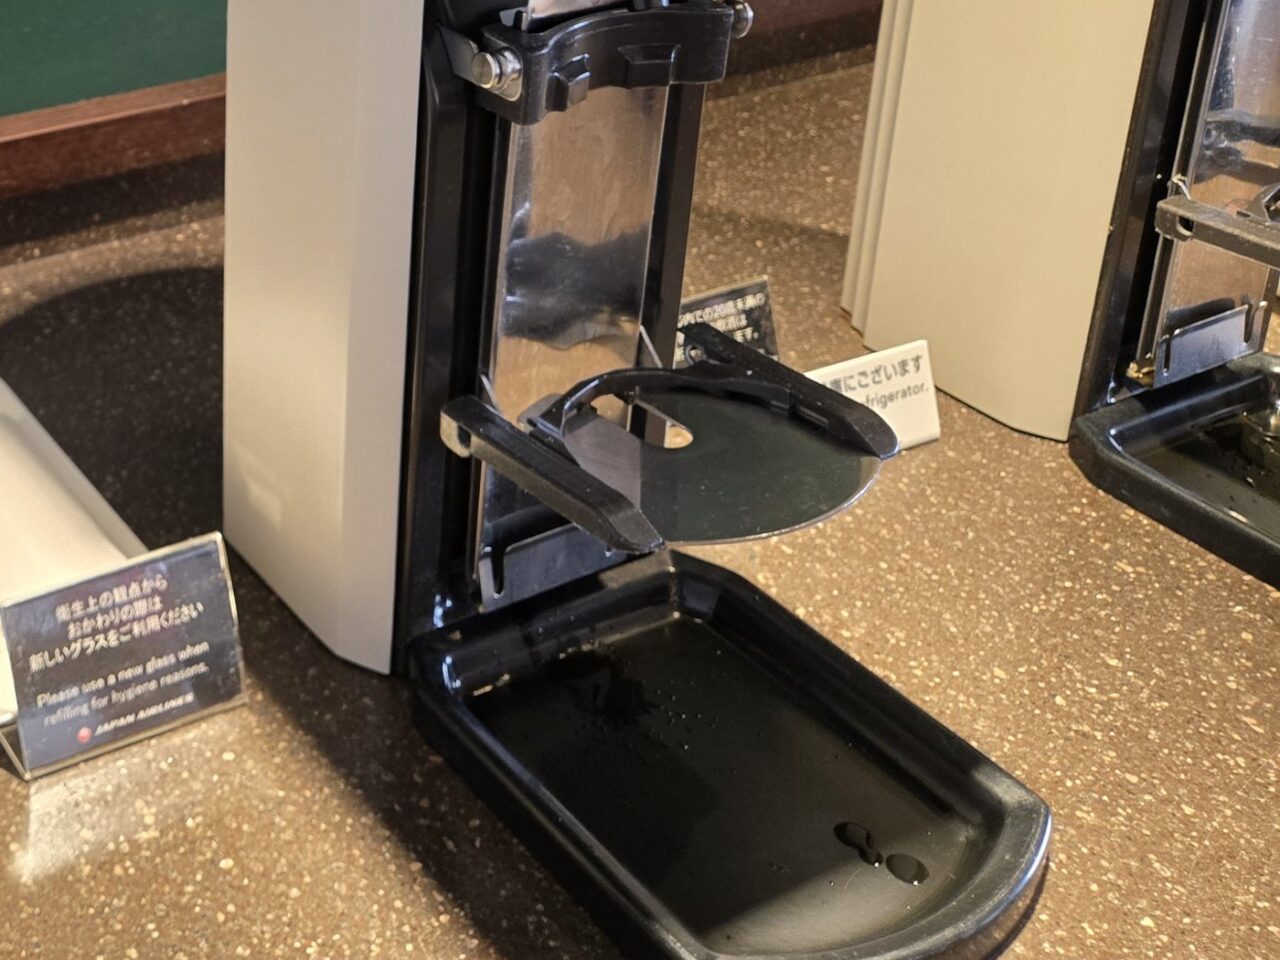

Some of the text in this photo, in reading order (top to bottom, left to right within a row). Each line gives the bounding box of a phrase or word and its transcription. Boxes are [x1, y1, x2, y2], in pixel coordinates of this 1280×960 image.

[862, 382, 928, 409] frigerator.
[36, 641, 210, 709] Please use a new glass when
[43, 702, 91, 728] refilling
[90, 695, 110, 710] for
[110, 679, 159, 704] hygiene
[94, 692, 195, 736] JAPAN AIRLINES
